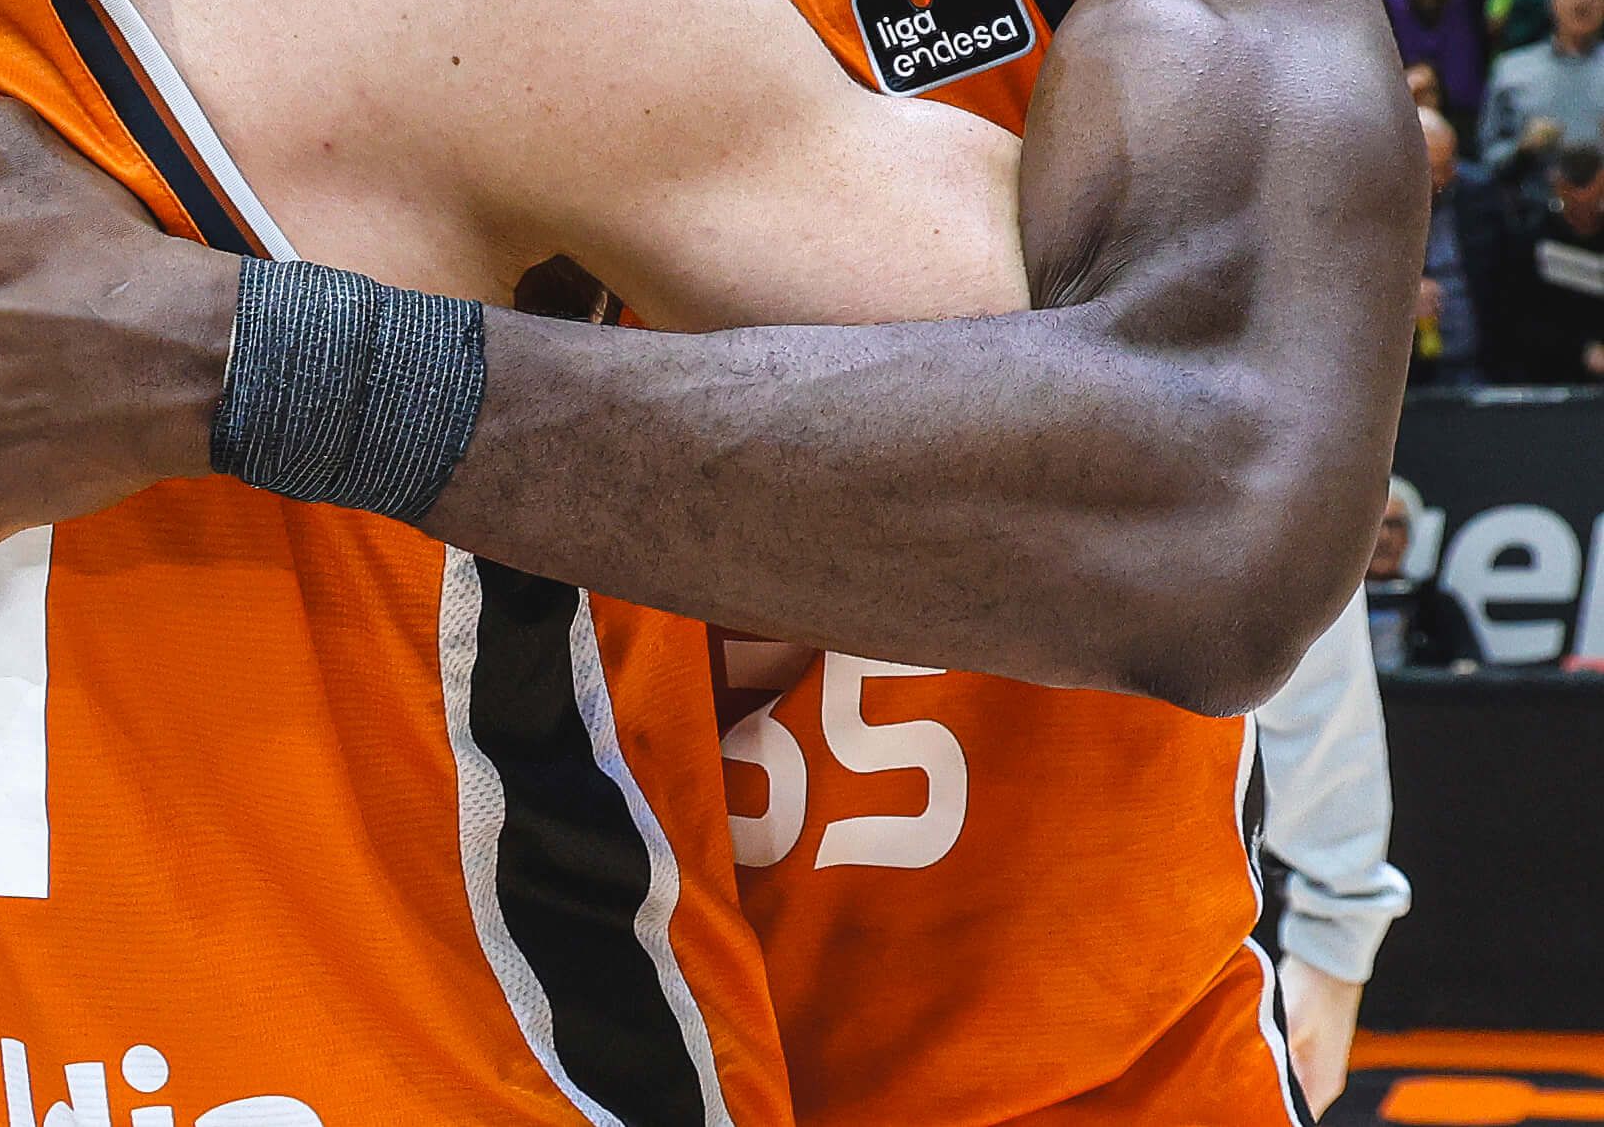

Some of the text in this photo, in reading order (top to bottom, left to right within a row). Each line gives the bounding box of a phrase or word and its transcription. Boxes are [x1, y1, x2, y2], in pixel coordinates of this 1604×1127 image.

[876, 9, 937, 49] liga
[893, 15, 1018, 77] endesa
[720, 640, 968, 870] 35
